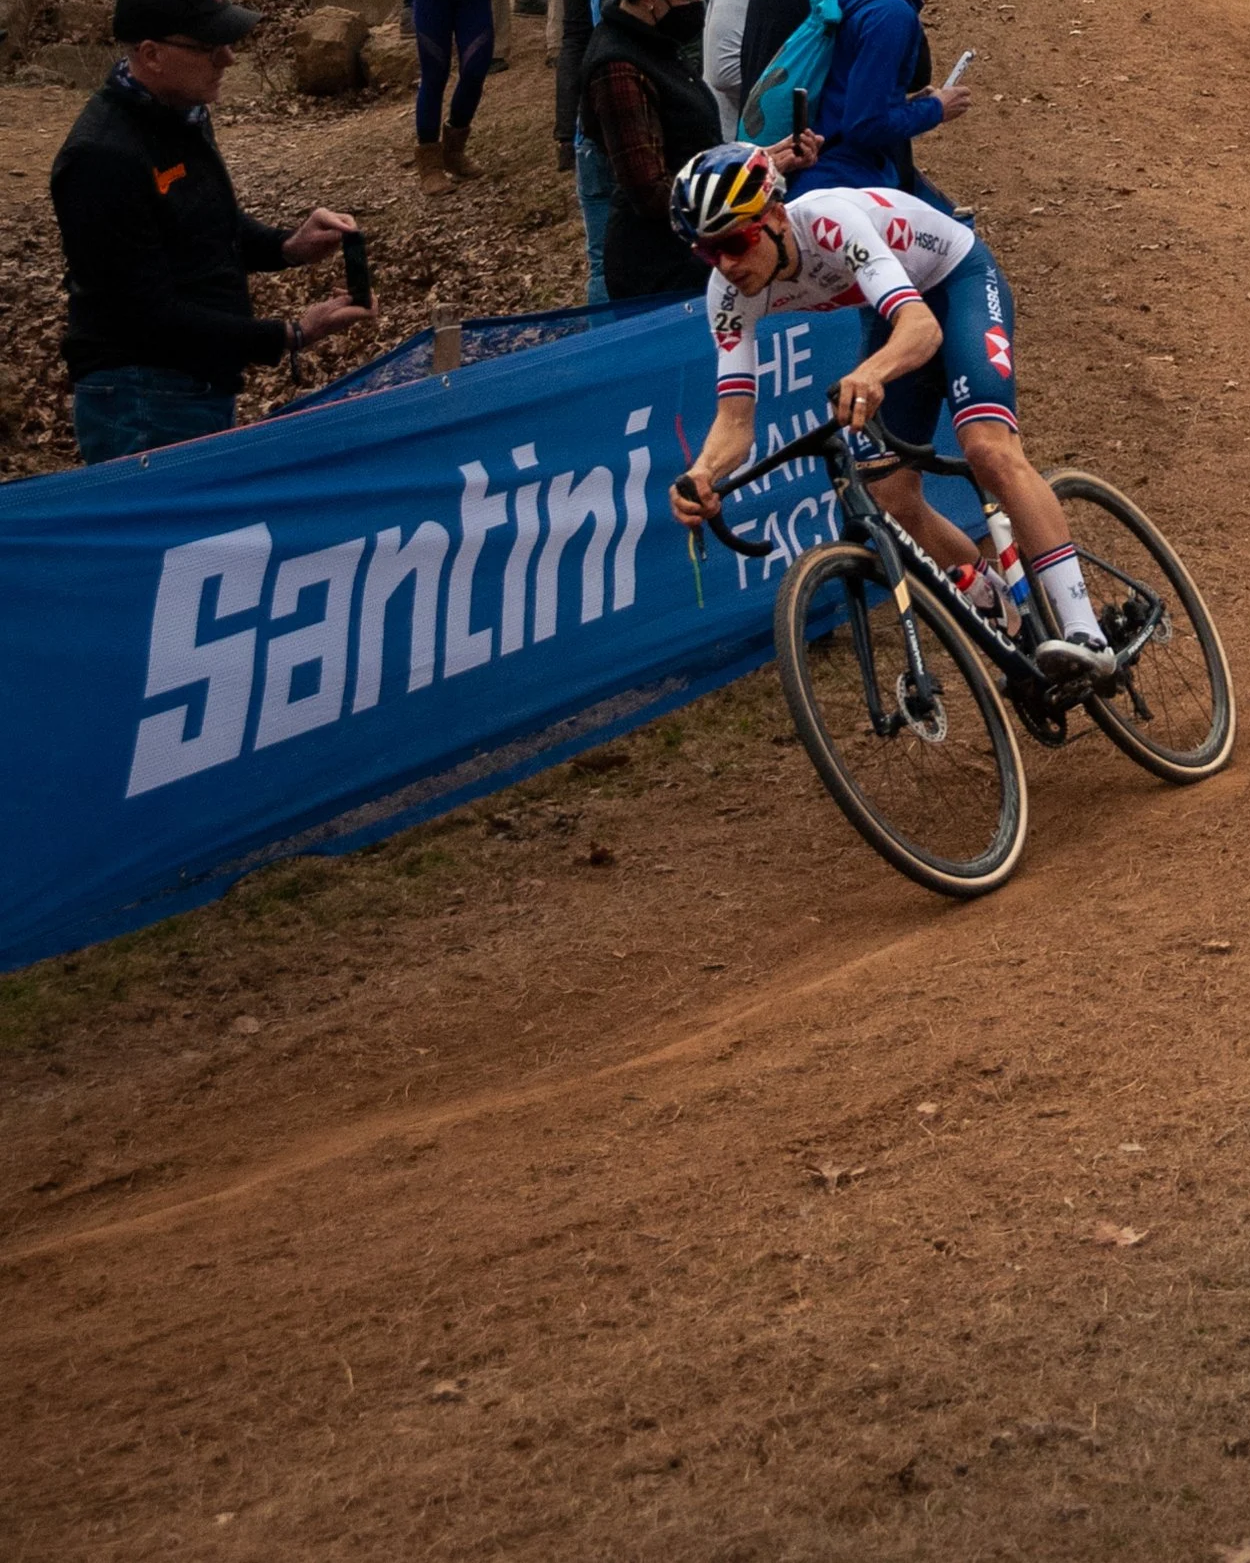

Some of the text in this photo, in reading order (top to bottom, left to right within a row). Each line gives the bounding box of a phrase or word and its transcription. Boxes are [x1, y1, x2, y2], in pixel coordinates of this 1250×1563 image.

[845, 243, 870, 273] 26
[914, 230, 939, 253] HSBC
[715, 312, 743, 333] 26
[986, 283, 1004, 323] HSBC
[754, 322, 813, 405] HE
[731, 489, 839, 590] FACT
[125, 405, 653, 799] Santini
